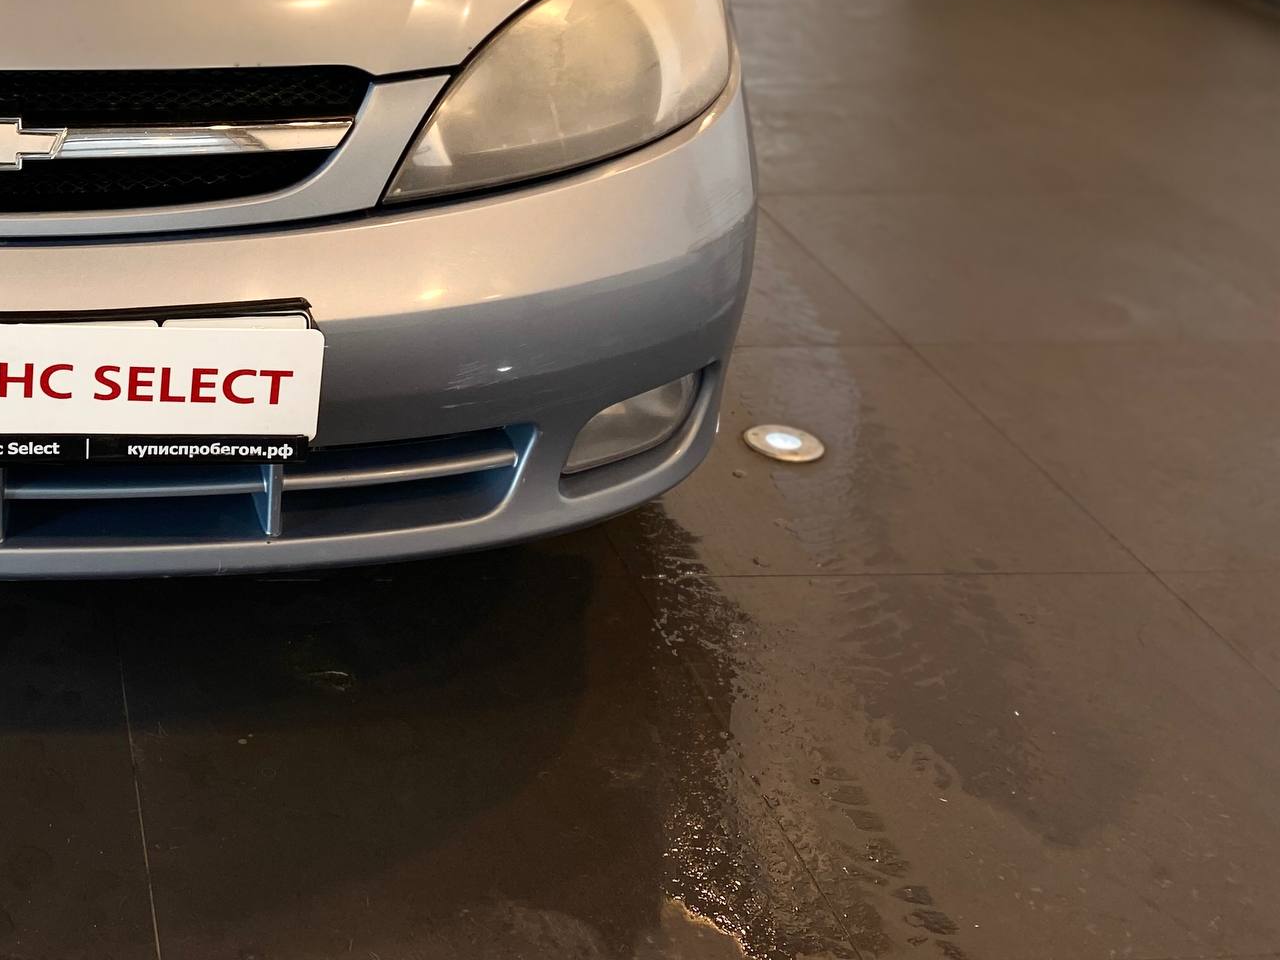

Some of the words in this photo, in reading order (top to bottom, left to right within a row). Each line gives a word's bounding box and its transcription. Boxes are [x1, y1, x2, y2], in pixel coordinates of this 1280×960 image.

[94, 365, 294, 406] SELECT
[7, 442, 61, 456] Select
[127, 442, 294, 459] куписпробегом.рф
